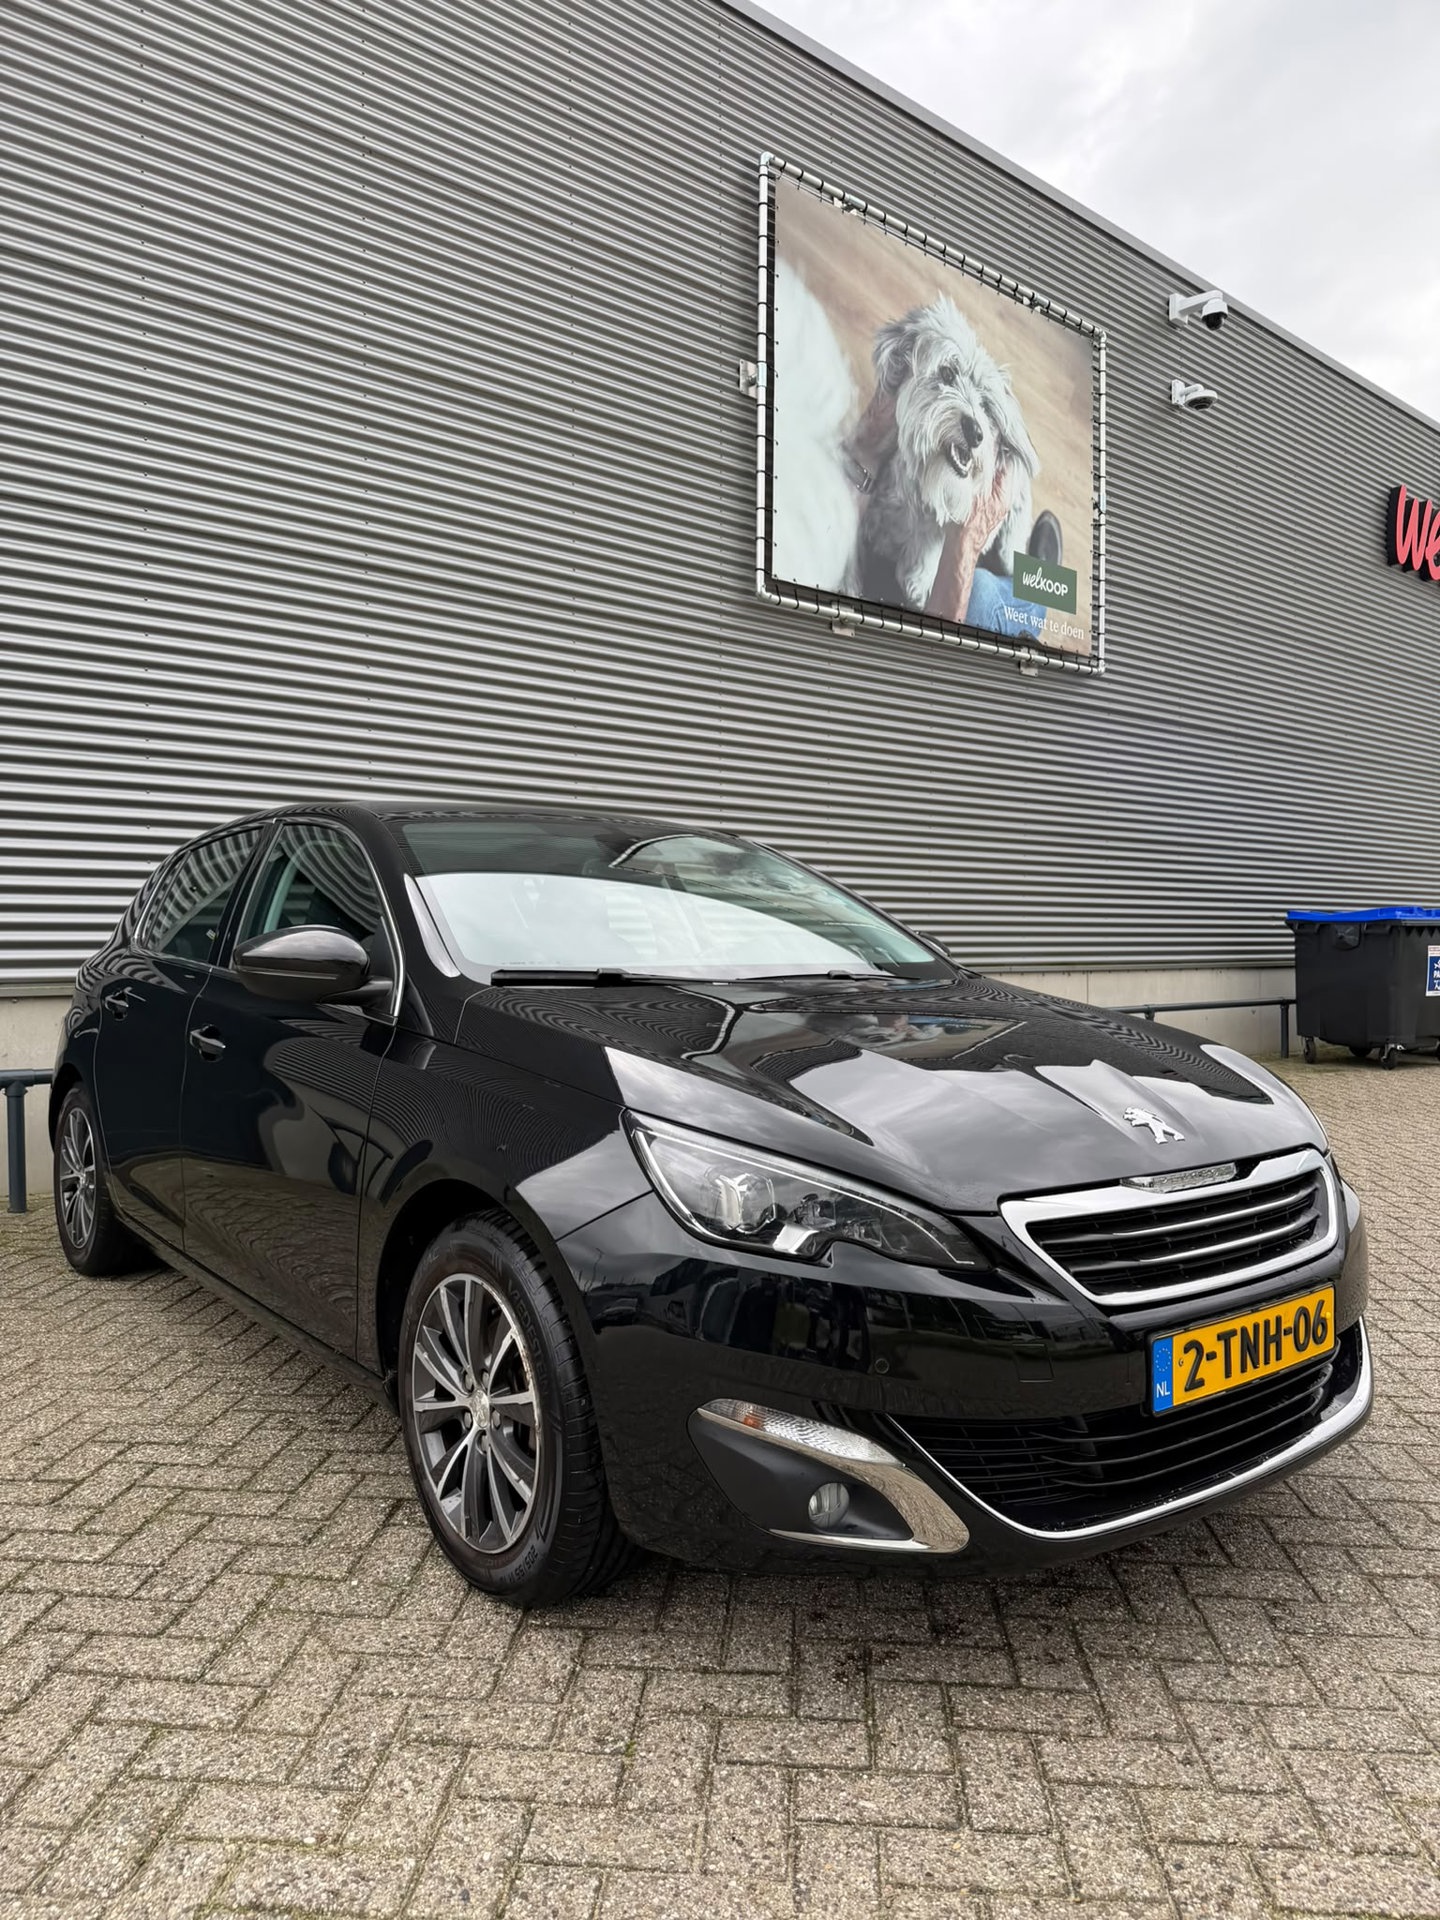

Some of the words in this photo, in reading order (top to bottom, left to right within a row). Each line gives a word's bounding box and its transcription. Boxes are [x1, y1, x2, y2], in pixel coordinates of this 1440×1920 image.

[1004, 606, 1029, 625] Weet
[1030, 614, 1047, 631] wat
[1049, 620, 1059, 635] te
[1061, 622, 1084, 640] doen
[508, 1279, 549, 1396] VREDESTEIN
[1183, 1299, 1328, 1392] 2-TNH-06
[1156, 1381, 1171, 1398] NL
